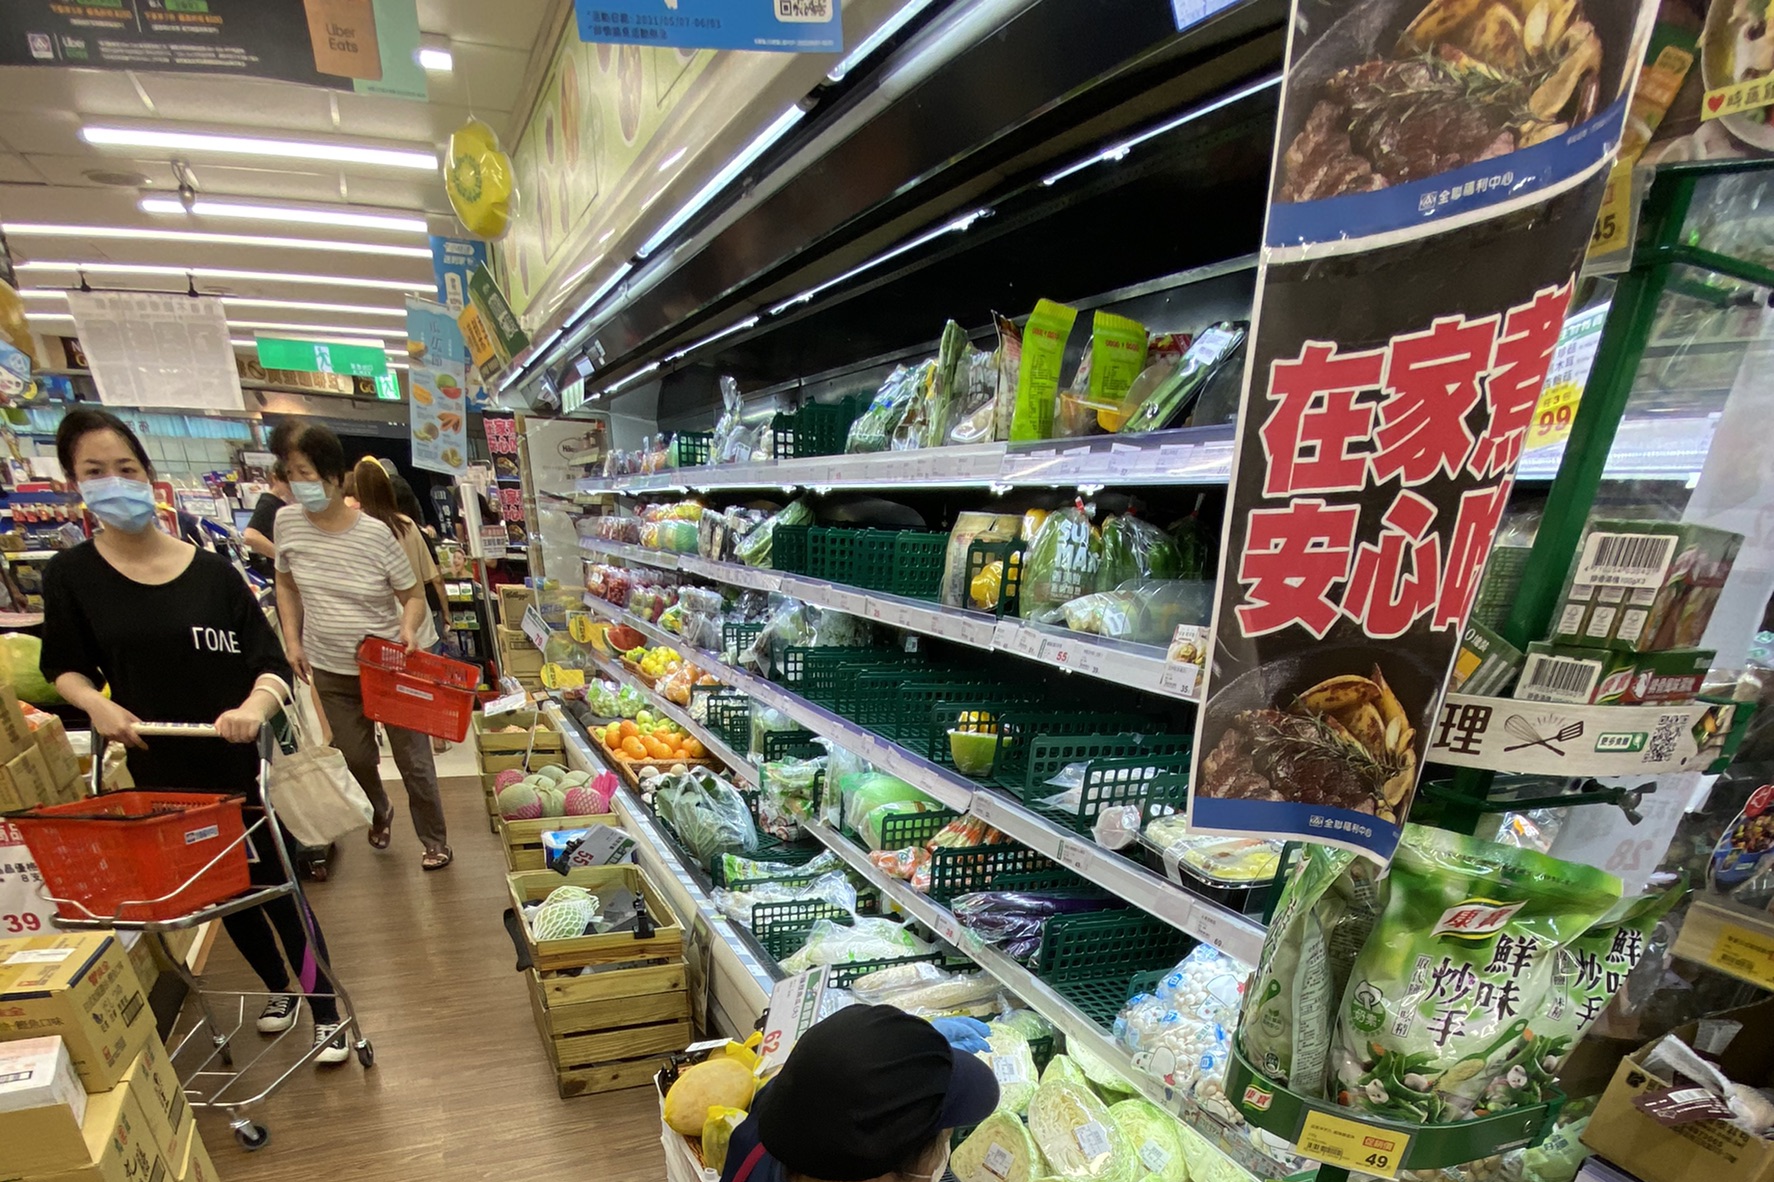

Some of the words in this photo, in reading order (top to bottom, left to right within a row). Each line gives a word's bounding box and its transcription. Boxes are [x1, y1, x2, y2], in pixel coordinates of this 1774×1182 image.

[326, 24, 355, 38] Uber
[329, 38, 358, 53] Eats
[1438, 171, 1514, 205] 全聯福利中心
[1538, 406, 1571, 437] 99
[1056, 651, 1068, 662] 55
[1432, 703, 1493, 755] 理
[1323, 816, 1373, 838] 全聯福利中心
[3, 912, 41, 933] 39
[761, 1029, 783, 1057] 62
[1364, 1153, 1389, 1168] 49
